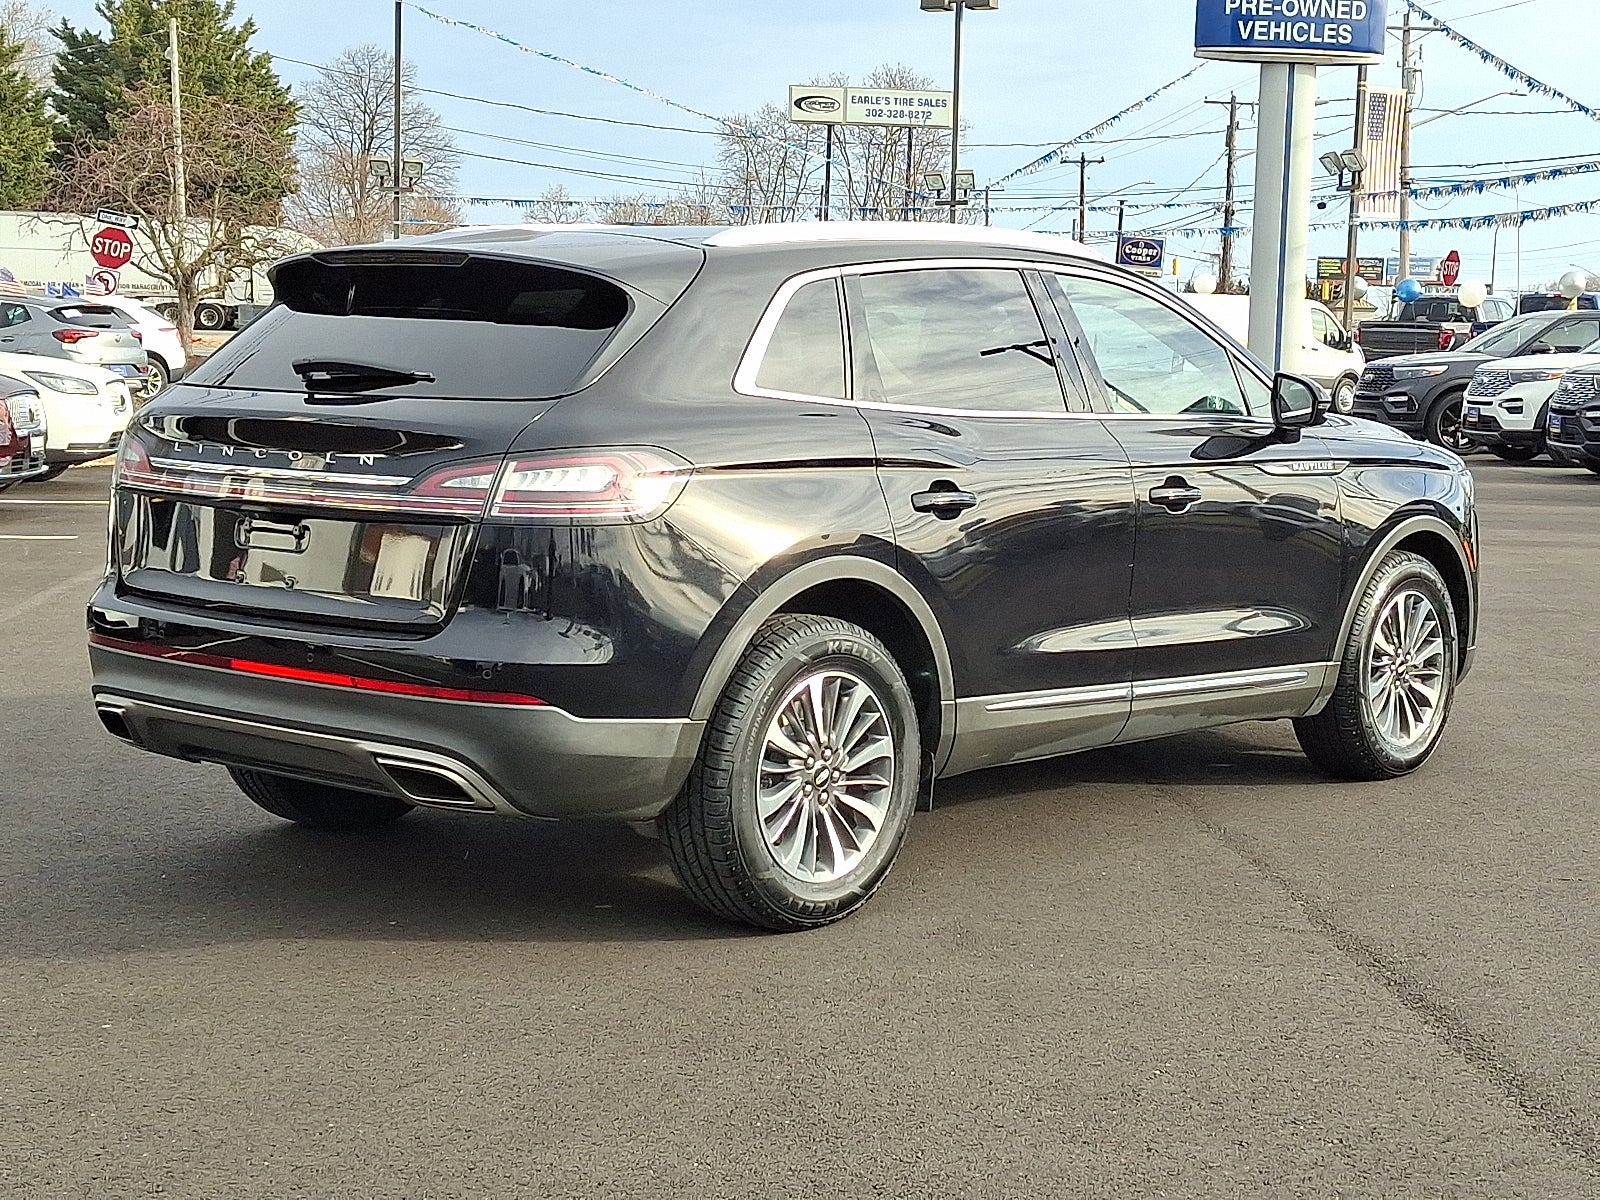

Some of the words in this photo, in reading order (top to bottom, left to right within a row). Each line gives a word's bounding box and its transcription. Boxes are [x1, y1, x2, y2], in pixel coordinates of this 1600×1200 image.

[1224, 0, 1367, 20] PRE-OWNED
[1237, 20, 1353, 44] VEHICLES
[851, 95, 891, 105] EARLE'S
[893, 97, 915, 106] TIRE
[917, 98, 947, 108] SALES
[93, 237, 131, 259] STOP
[1125, 245, 1158, 256] Cooper
[1444, 261, 1459, 276] STOP
[174, 442, 374, 467] LINCOLN
[828, 640, 880, 664] KELLY
